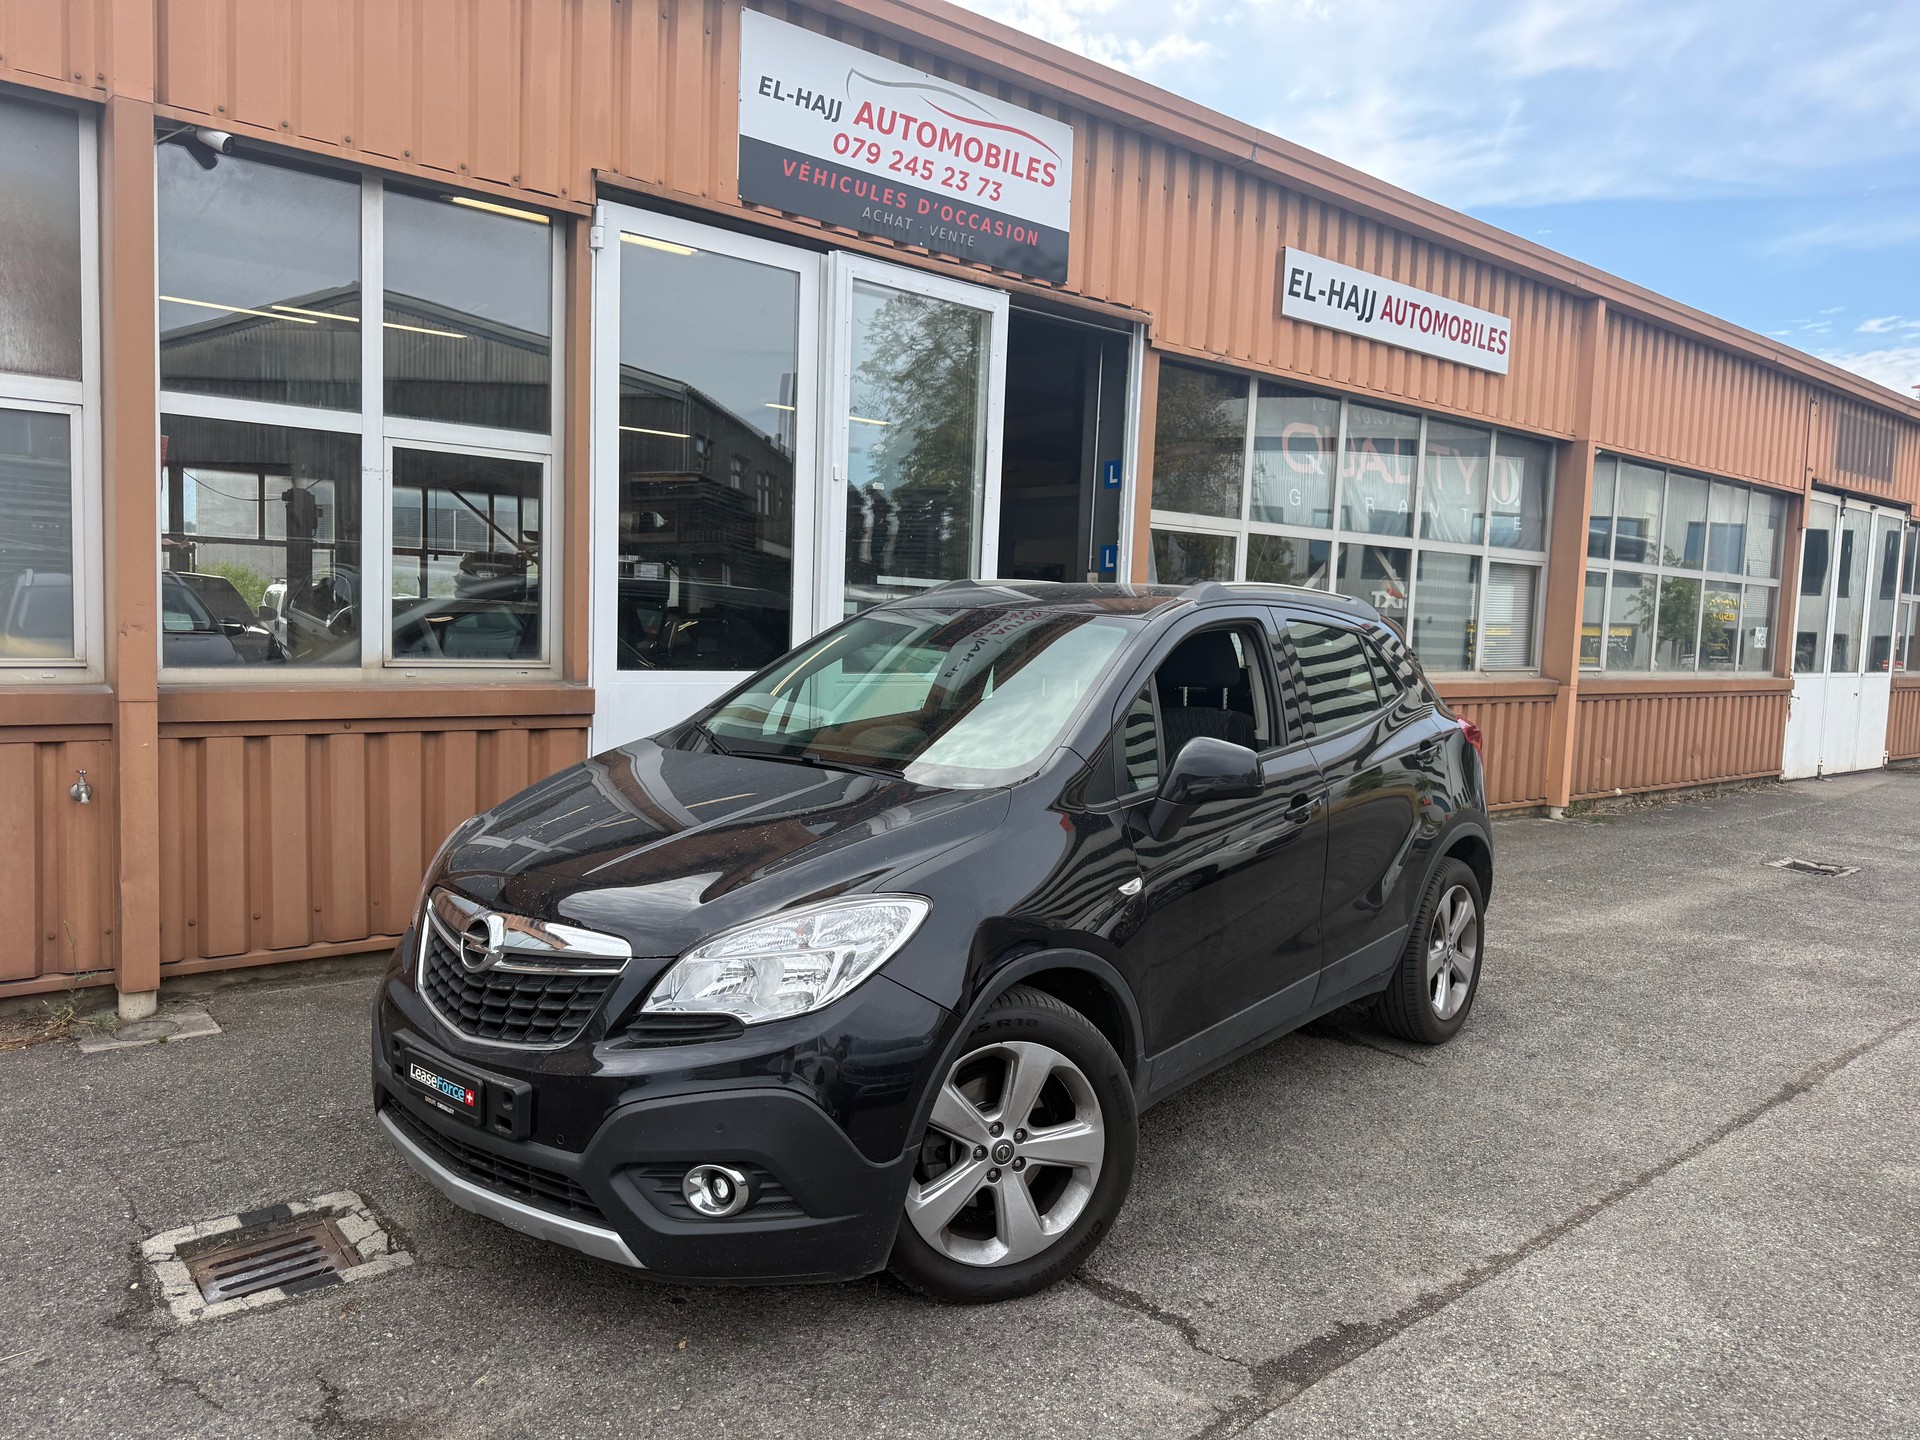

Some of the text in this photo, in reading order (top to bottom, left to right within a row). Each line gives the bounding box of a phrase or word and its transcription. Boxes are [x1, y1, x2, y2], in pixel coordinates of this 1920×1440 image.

[758, 75, 1058, 188] EL-HAJJ AUTOMOBILES
[782, 159, 907, 209] VÉHICULES
[832, 132, 1003, 203] 079 245 23 73
[861, 207, 976, 248] ACHAT VENTE
[1288, 267, 1508, 356] EL-HAJJ AUTOMOBILES
[1109, 465, 1118, 484] L
[1105, 549, 1114, 568] L
[410, 1063, 465, 1100] LeaseForce
